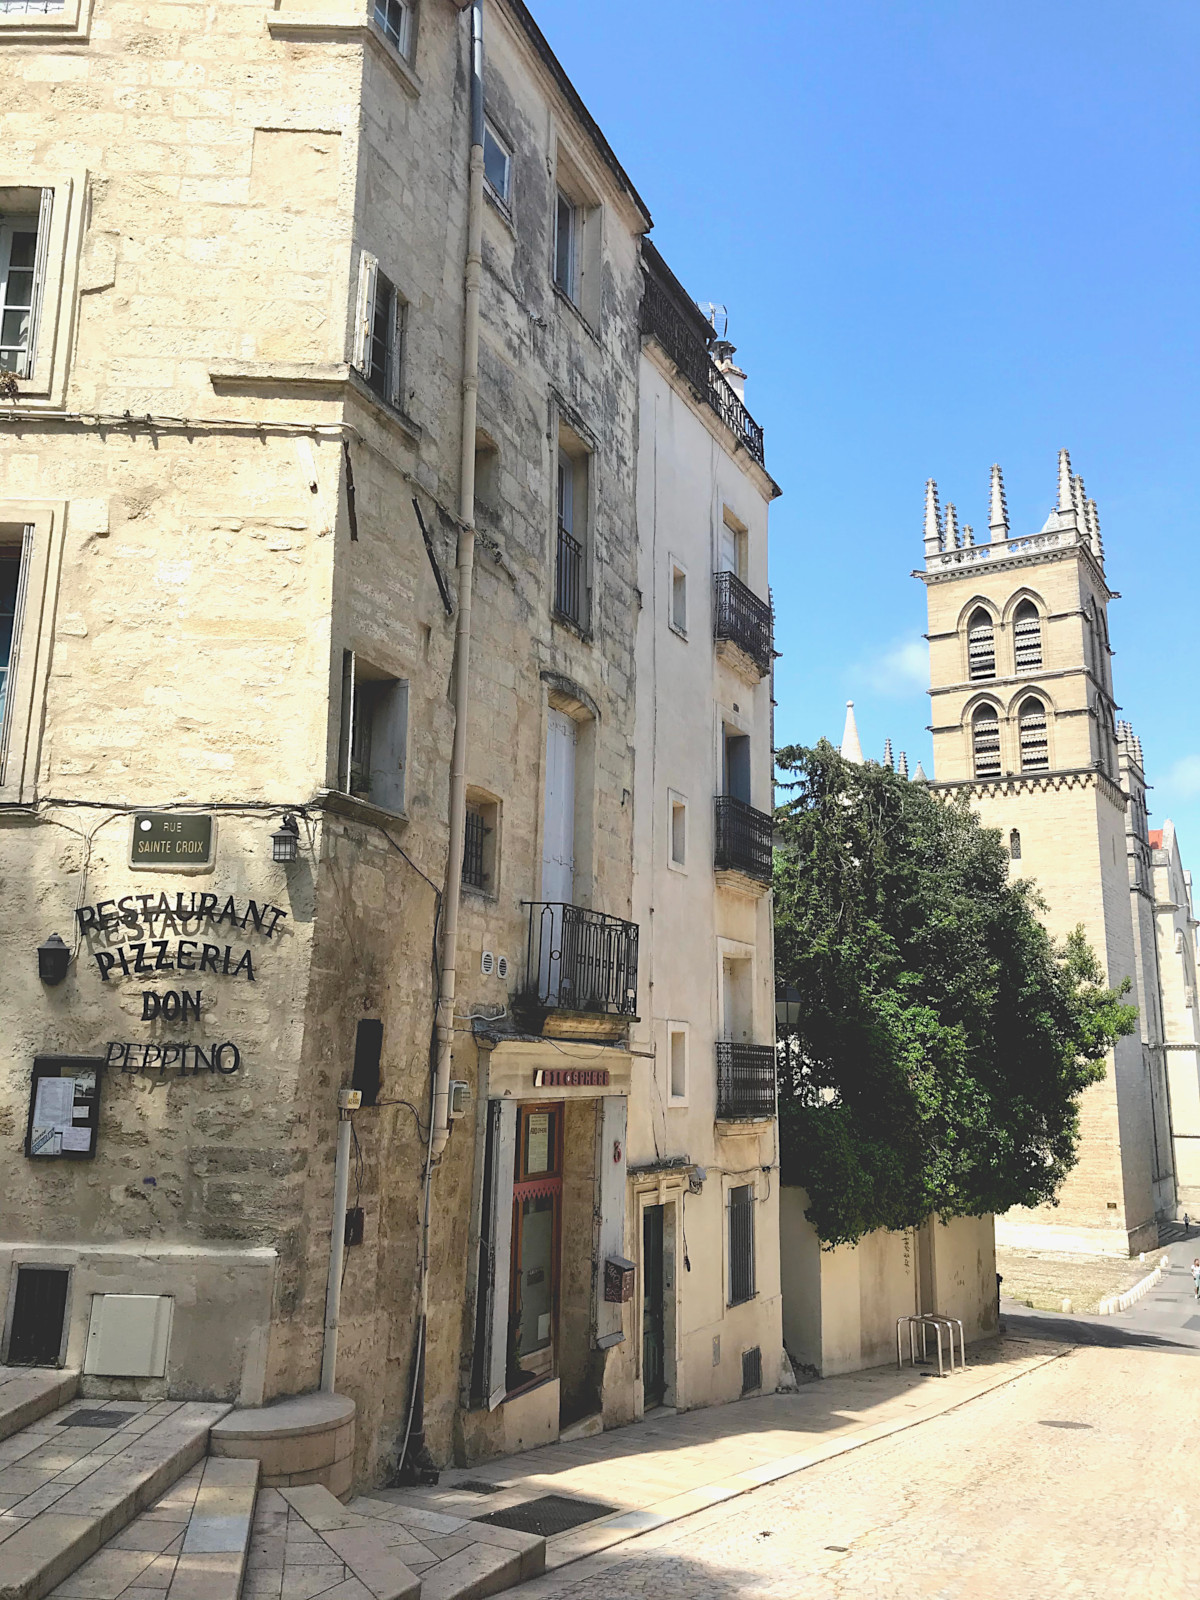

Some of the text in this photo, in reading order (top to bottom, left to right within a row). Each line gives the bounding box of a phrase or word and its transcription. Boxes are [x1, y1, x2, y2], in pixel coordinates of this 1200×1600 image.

[163, 822, 182, 832] RUE
[138, 840, 204, 853] SAINTE CROIX
[75, 892, 288, 939] RESTAURANT
[93, 940, 256, 981] PIZZERIA
[141, 990, 203, 1022] DON
[106, 1042, 241, 1076] PEPPINO
